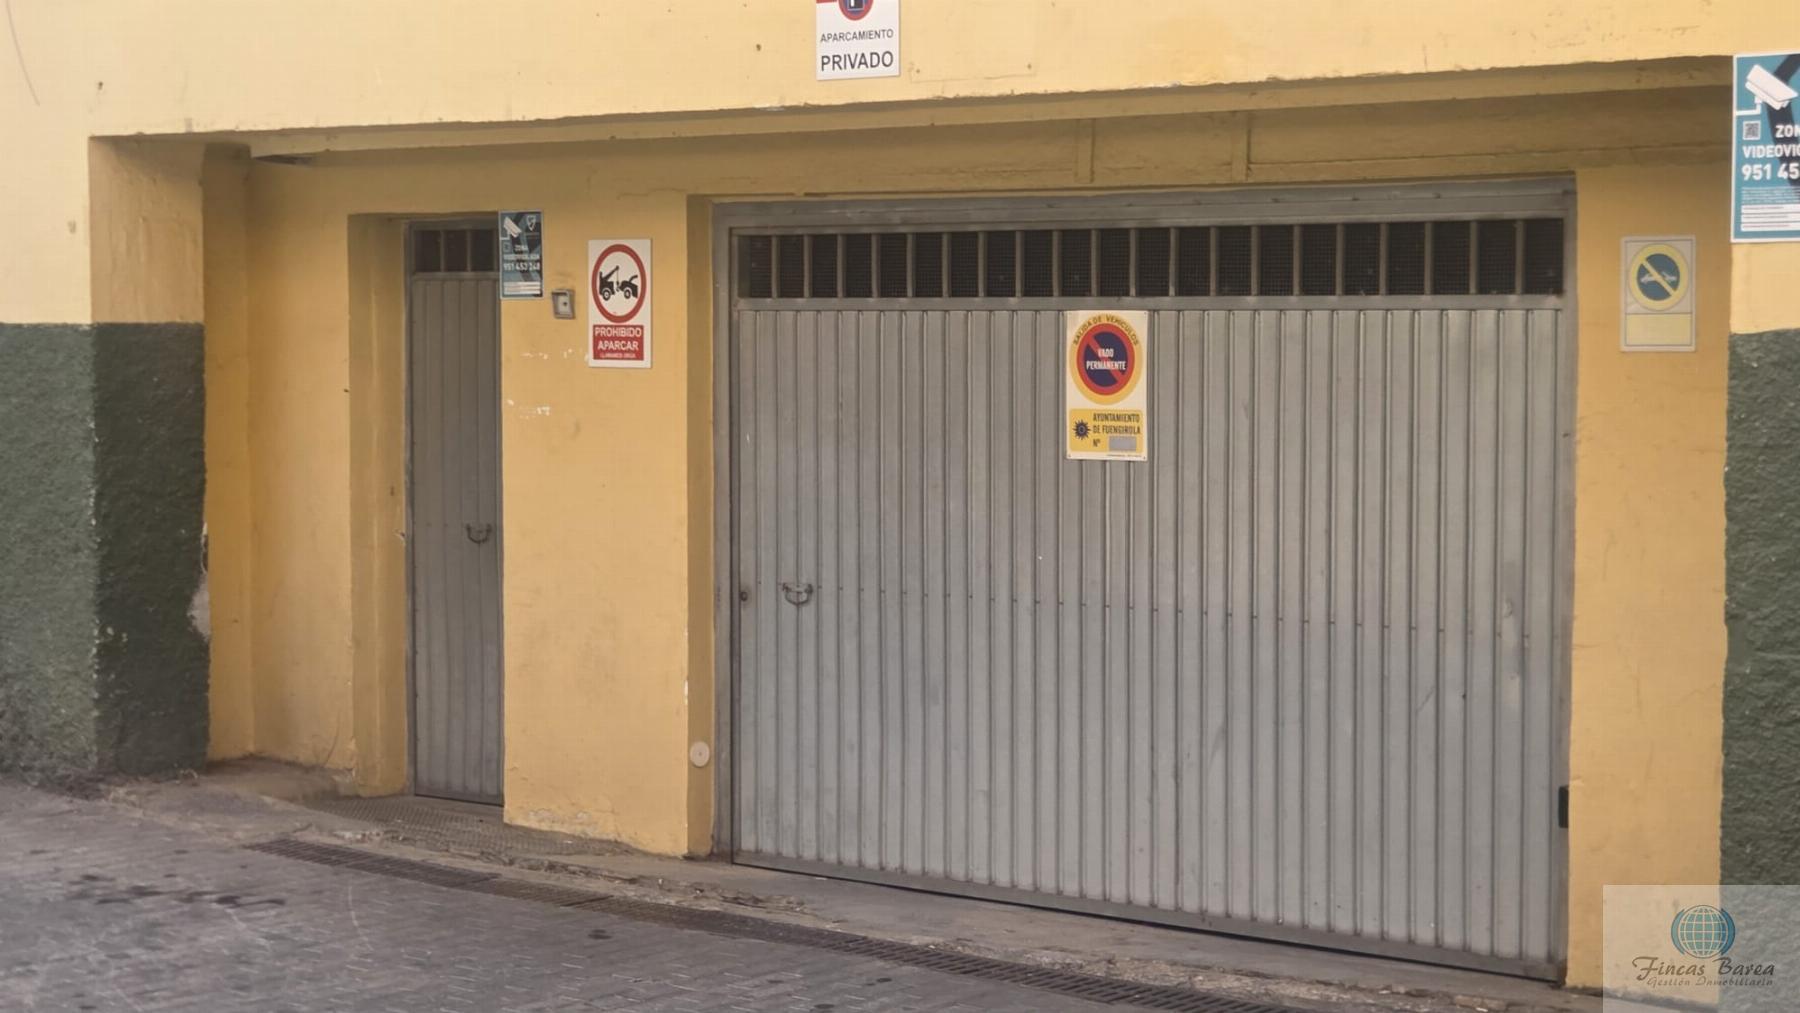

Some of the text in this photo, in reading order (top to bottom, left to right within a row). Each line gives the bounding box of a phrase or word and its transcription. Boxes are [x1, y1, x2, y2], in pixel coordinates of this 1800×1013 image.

[820, 29, 894, 42] APARCAMIENTO
[821, 50, 894, 72] PRIVADO
[1742, 163, 1772, 181] 951
[594, 326, 642, 338] PROHIBIDO
[597, 340, 640, 351] APARCAR
[1097, 347, 1115, 358] VADO
[1086, 360, 1127, 371] PERMANENTE
[1093, 412, 1141, 423] AYUNTAMIENTO
[1093, 424, 1141, 435] DE FUENGIROLA
